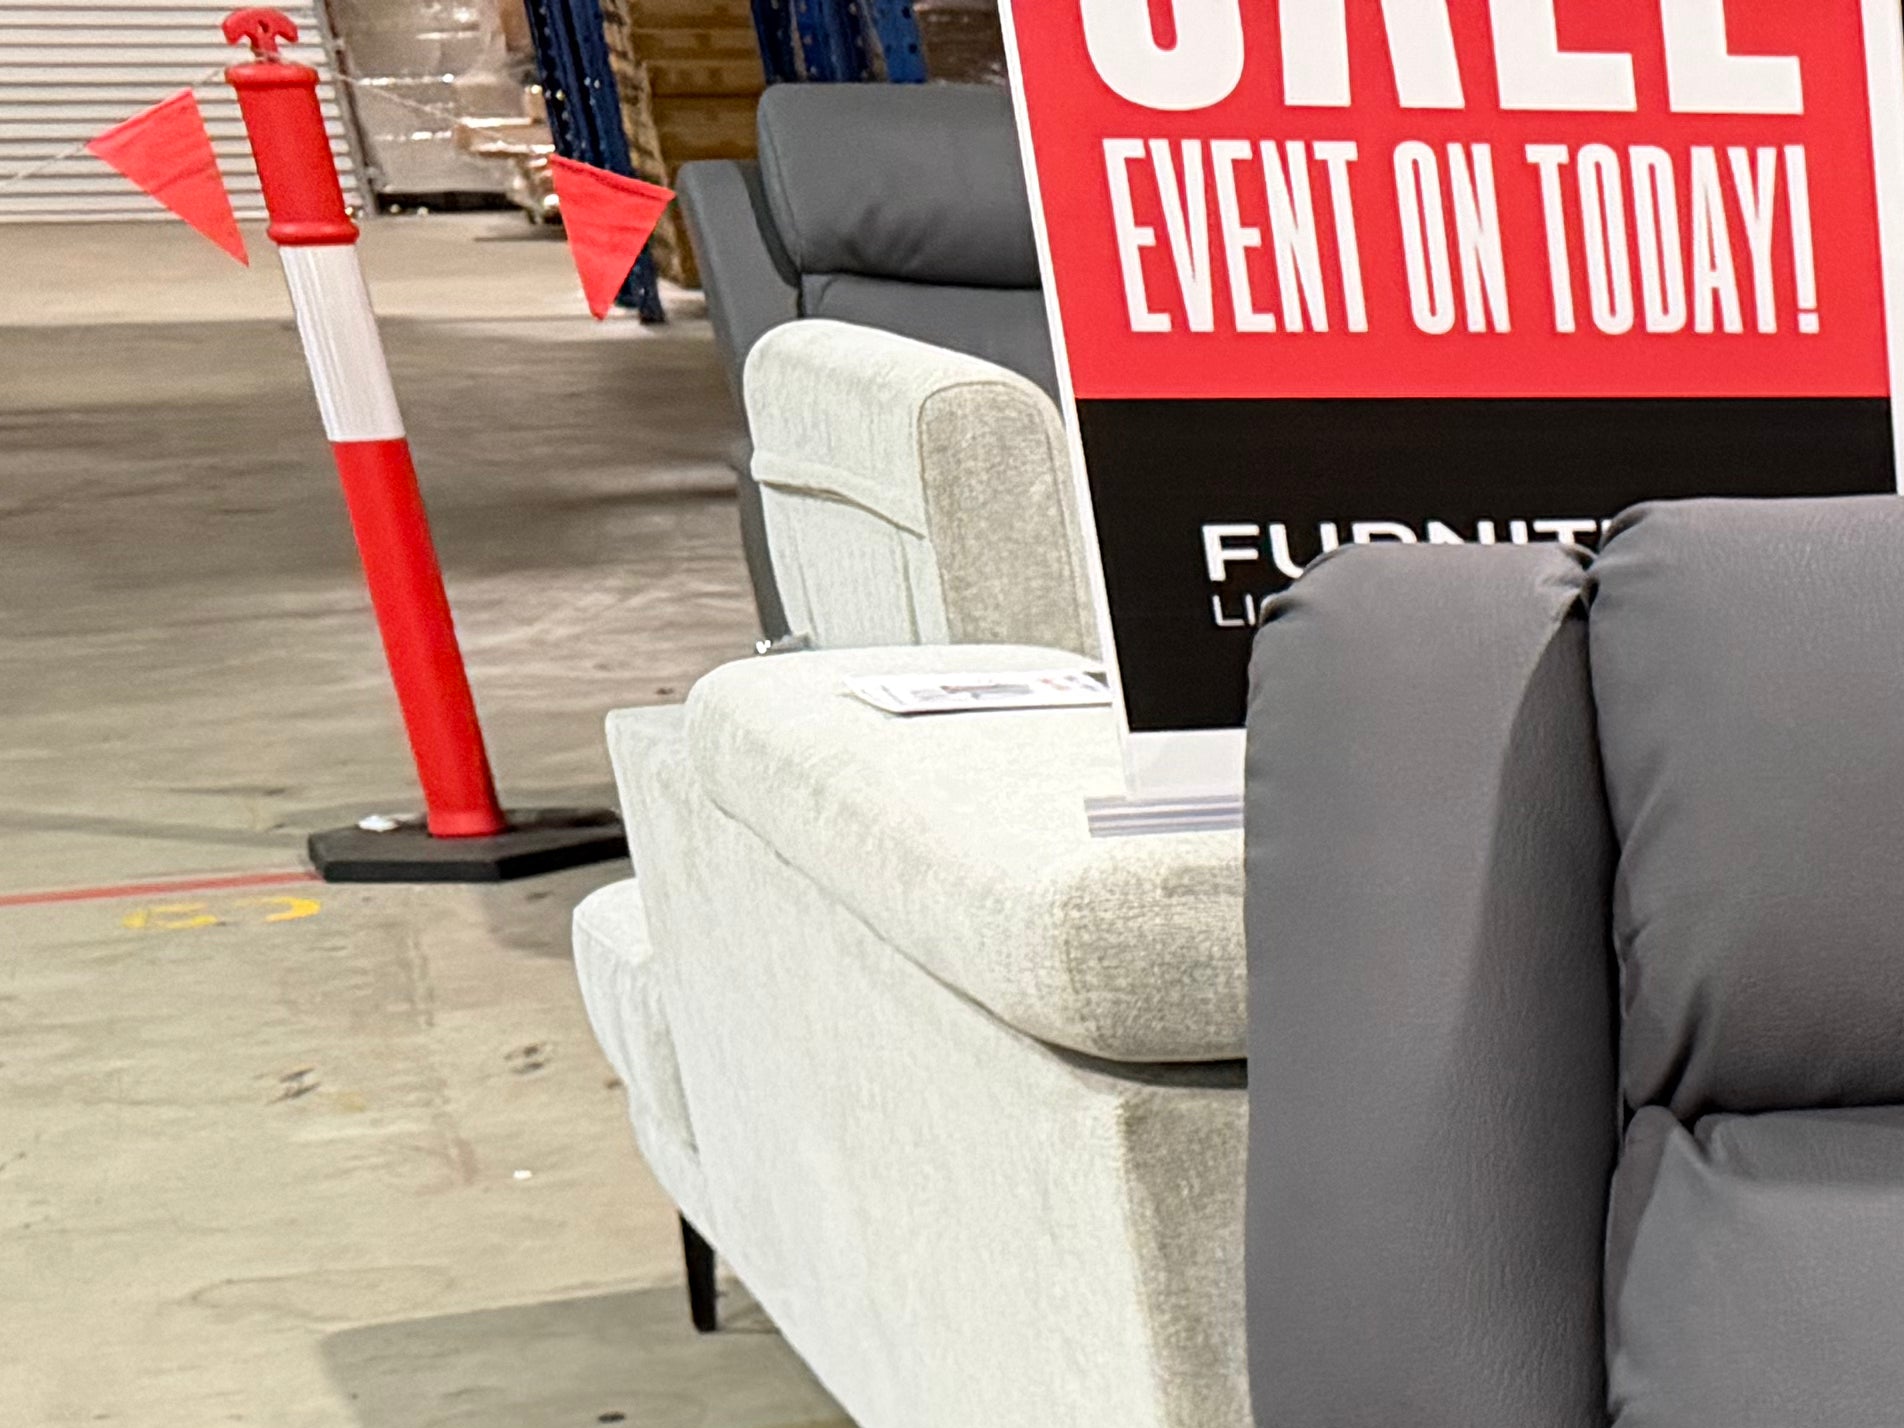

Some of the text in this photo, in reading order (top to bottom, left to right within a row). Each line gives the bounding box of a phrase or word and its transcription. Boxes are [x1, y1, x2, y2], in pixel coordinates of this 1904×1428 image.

[1102, 138, 1819, 335] EVENT ON TODAY!
